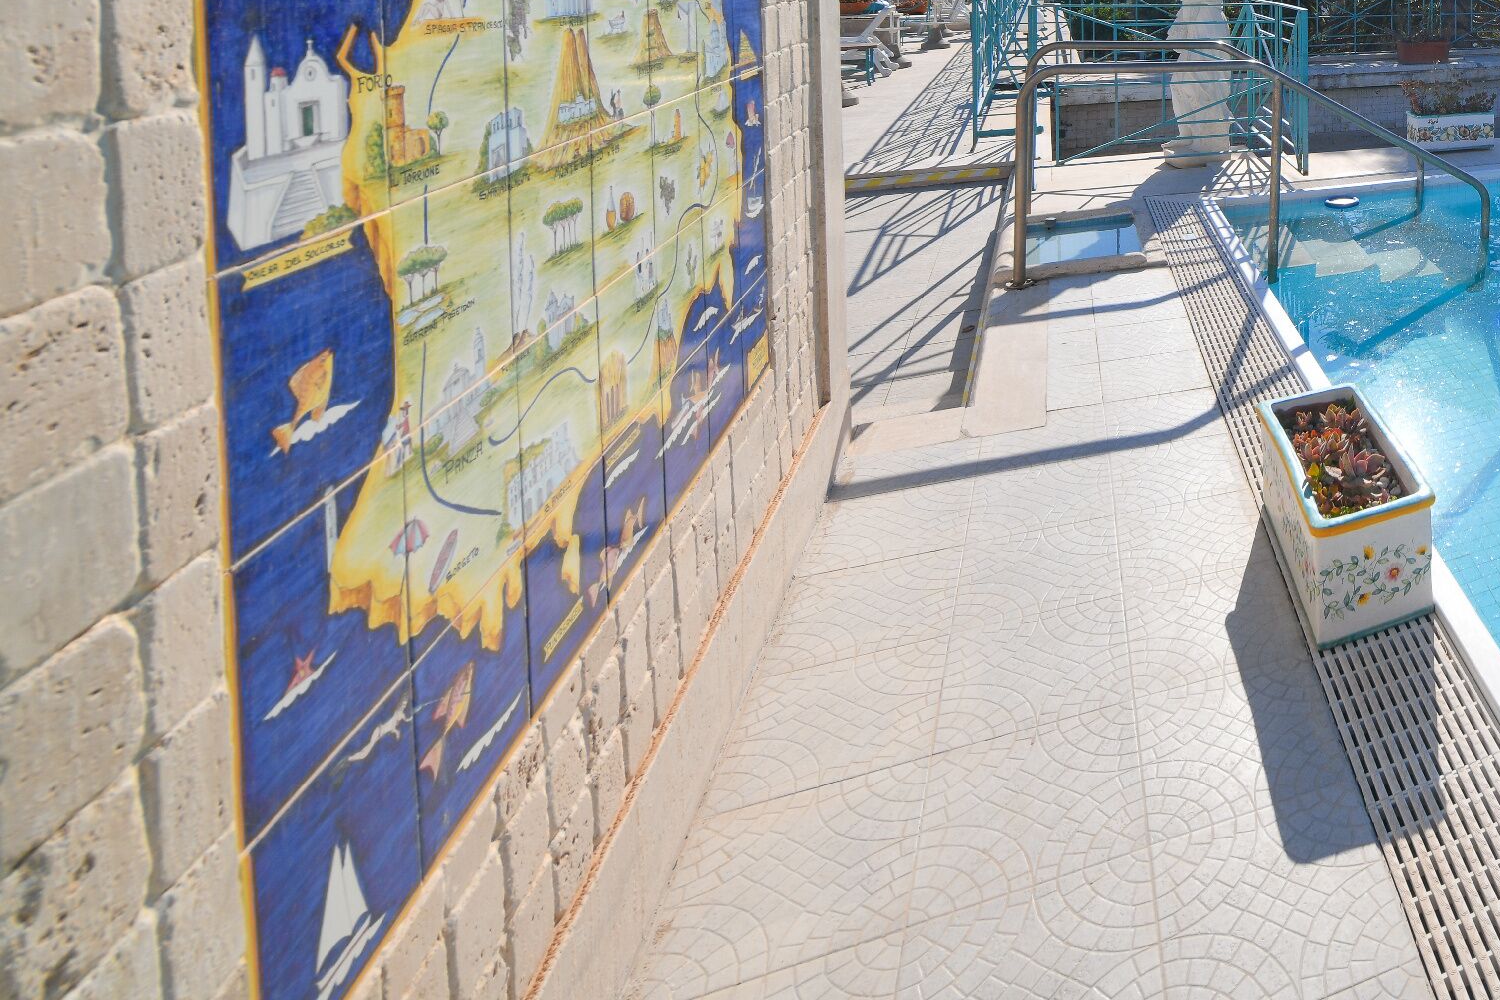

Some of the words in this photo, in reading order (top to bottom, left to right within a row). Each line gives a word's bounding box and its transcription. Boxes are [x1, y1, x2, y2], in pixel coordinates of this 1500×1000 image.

[357, 74, 393, 94] FORIO
[400, 164, 440, 186] TORRIONE
[284, 257, 302, 270] DEL
[440, 298, 476, 326] POSEIDON
[442, 441, 484, 485] PANZA
[446, 546, 480, 583] SORGETO
